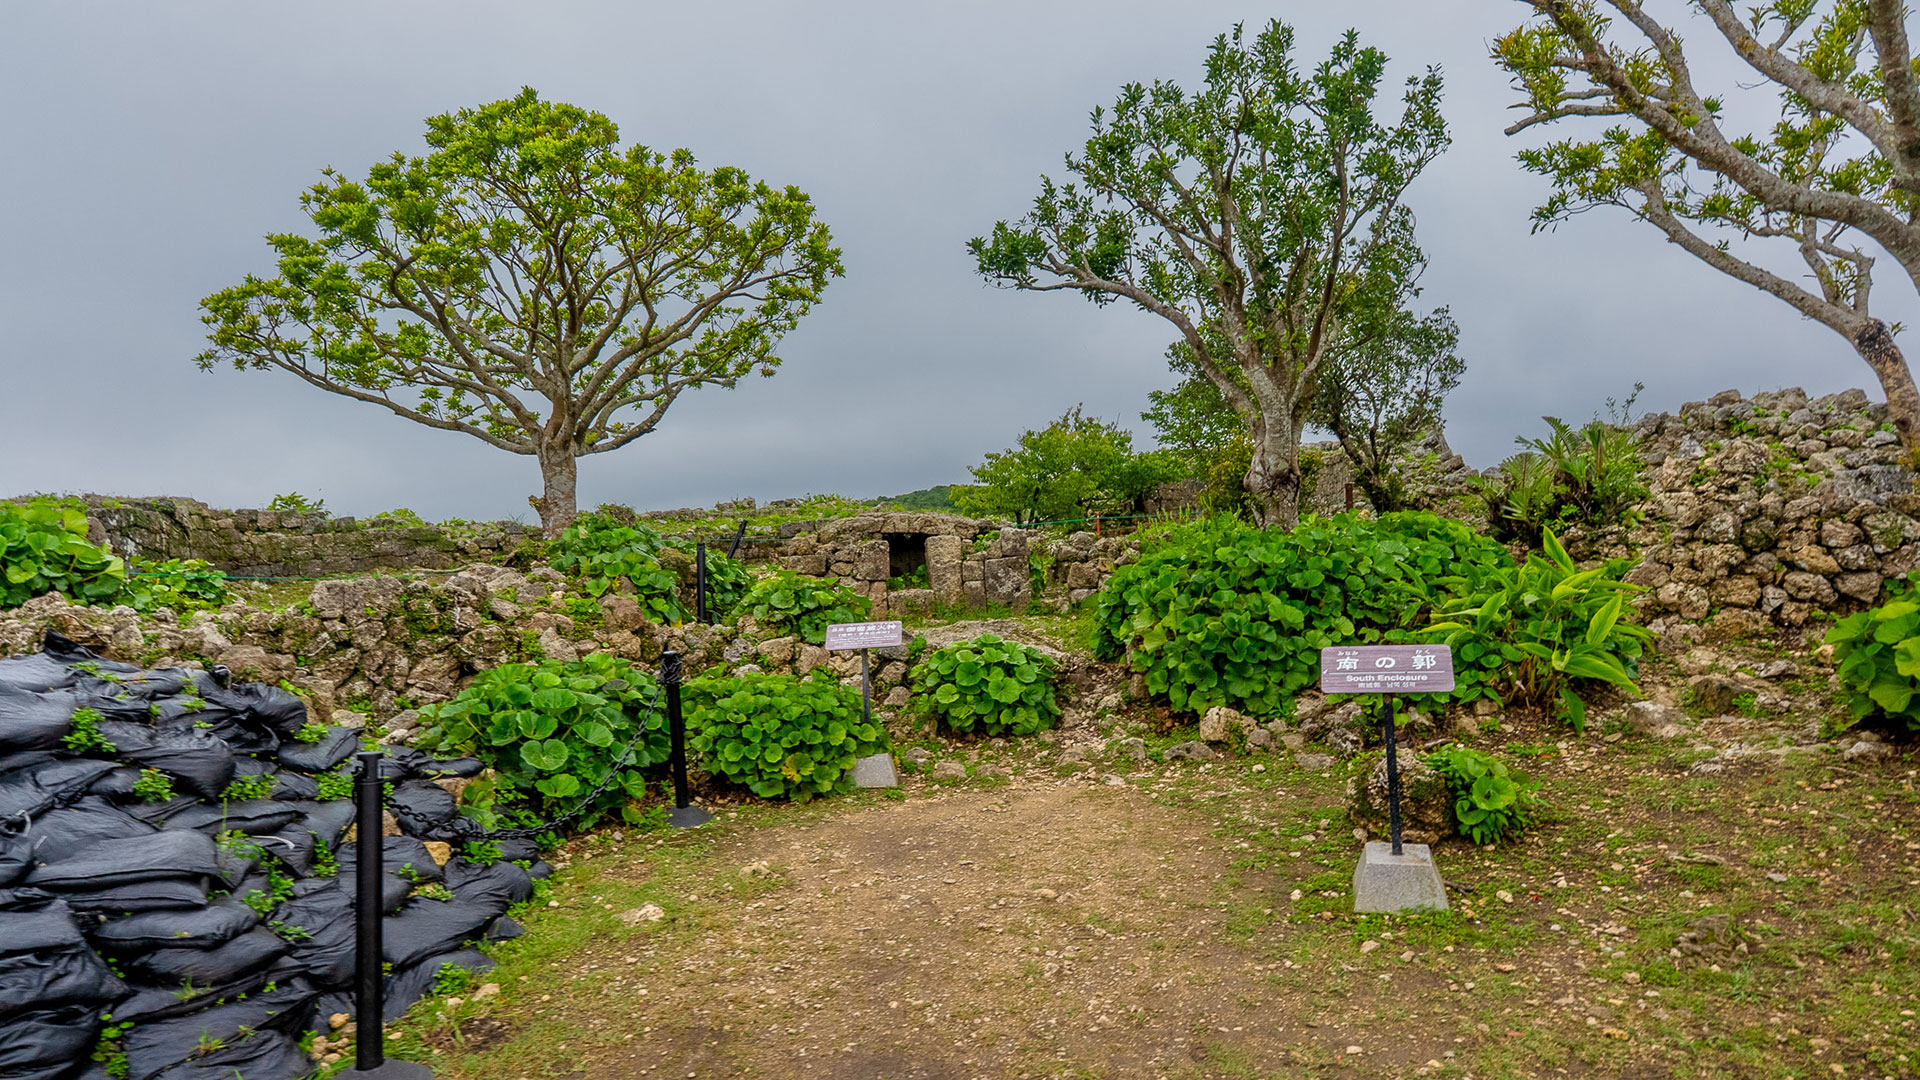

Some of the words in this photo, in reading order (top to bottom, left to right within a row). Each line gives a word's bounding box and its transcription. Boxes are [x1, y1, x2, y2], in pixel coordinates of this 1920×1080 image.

[1336, 655, 1437, 671] 南の郭
[1346, 674, 1375, 682] South
